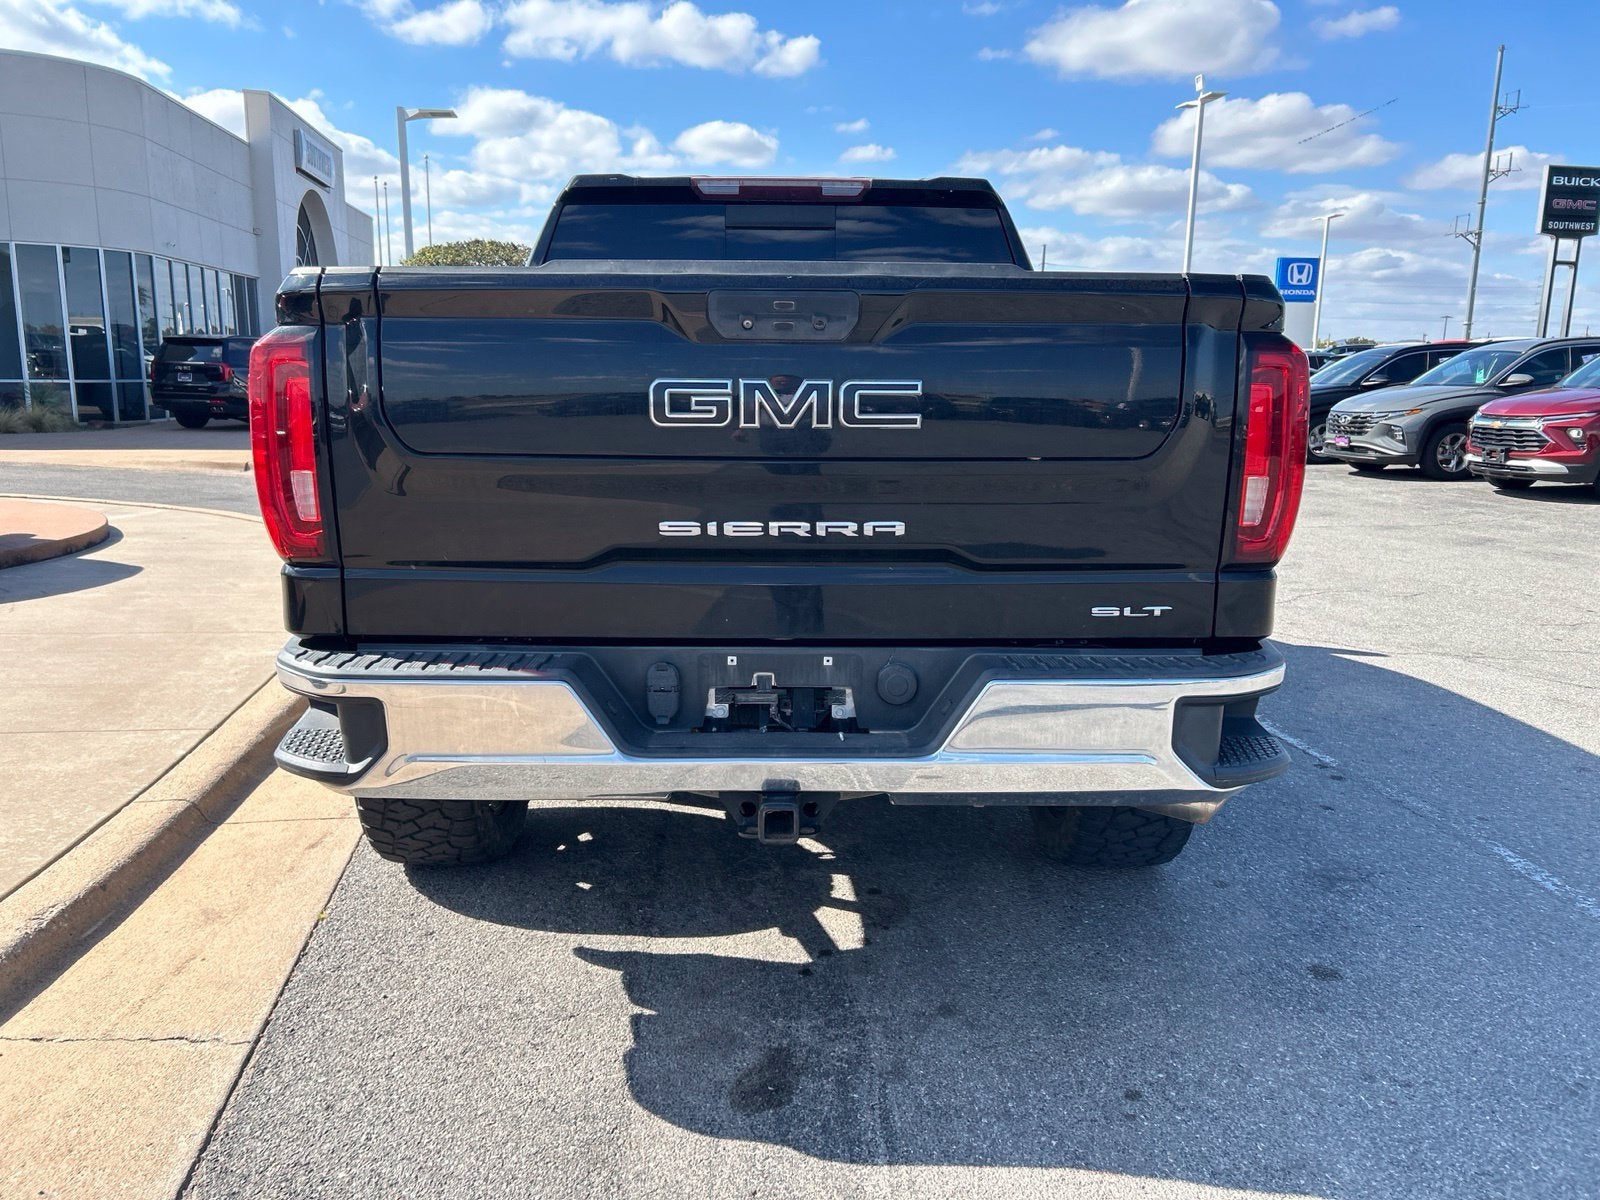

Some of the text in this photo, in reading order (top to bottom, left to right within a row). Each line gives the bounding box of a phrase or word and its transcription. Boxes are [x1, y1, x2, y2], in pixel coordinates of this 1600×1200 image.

[1552, 176, 1600, 187] BUICK
[1552, 198, 1597, 210] GMC
[1548, 221, 1596, 231] SOUTHWEST
[649, 378, 922, 429] GMC
[658, 521, 906, 537] SIERRA
[1091, 606, 1173, 617] SLT
